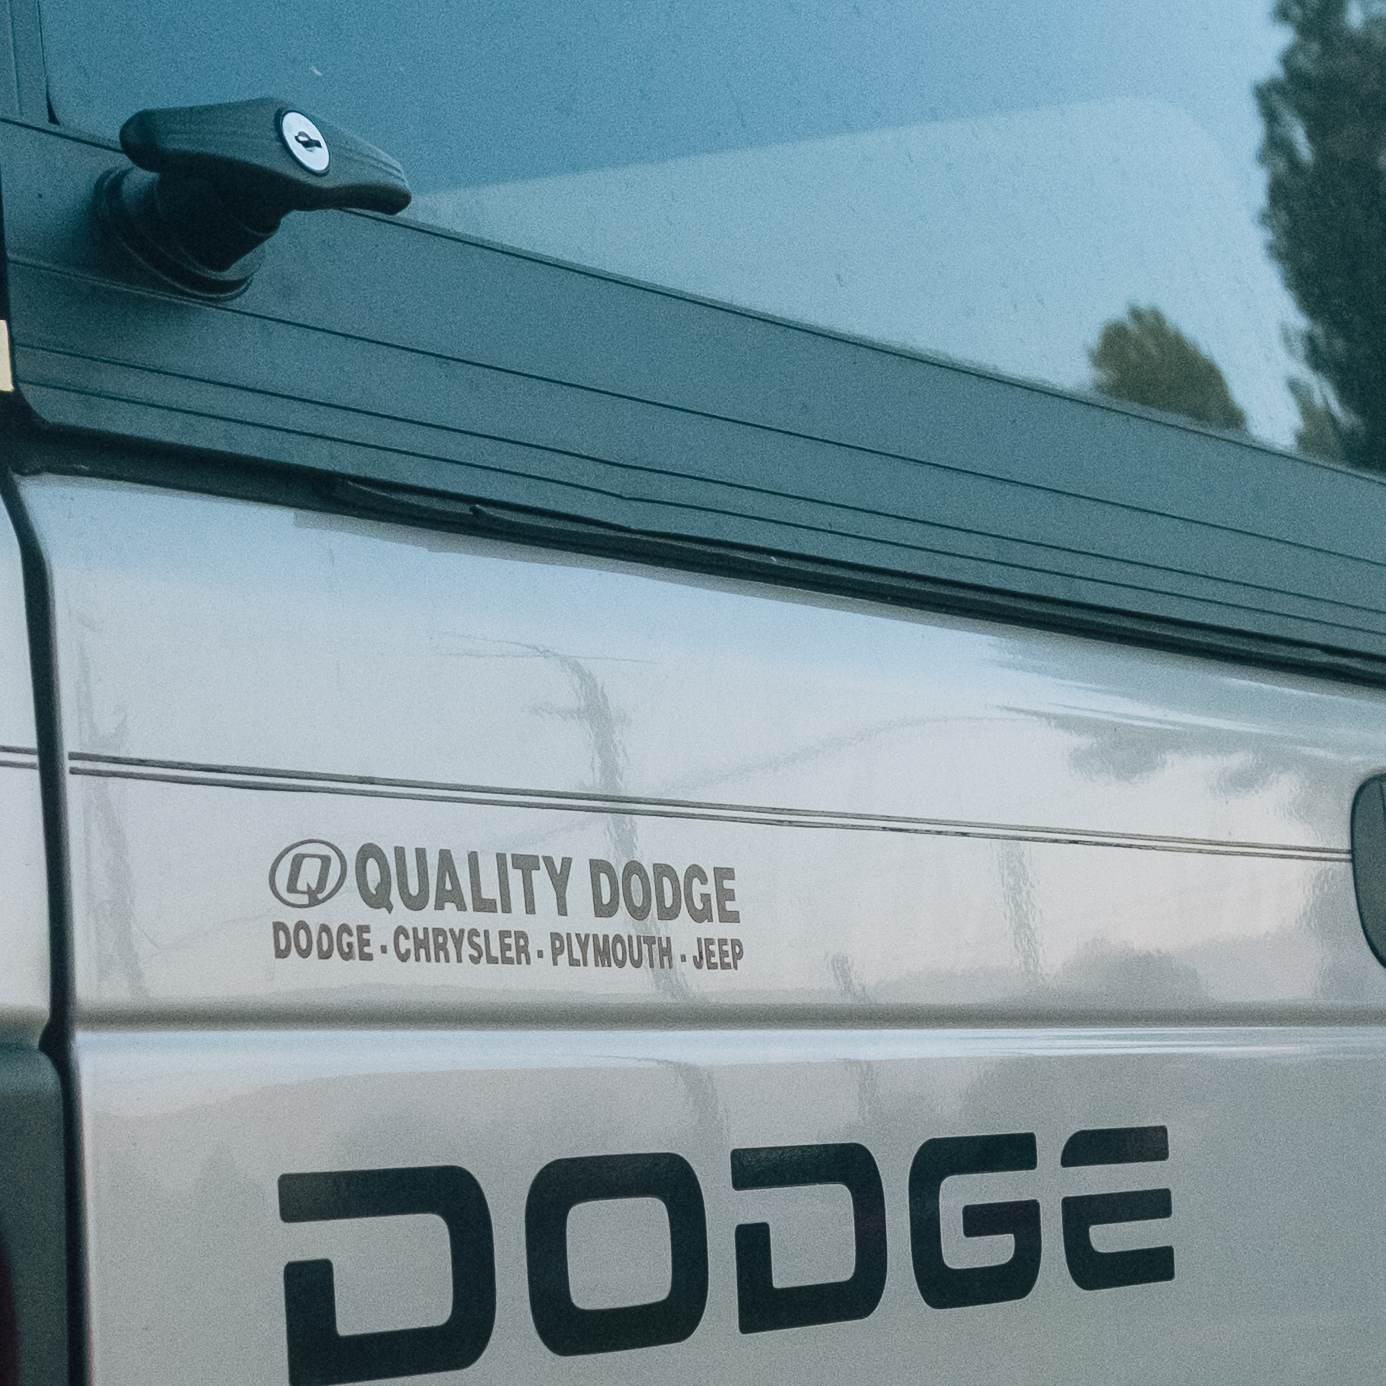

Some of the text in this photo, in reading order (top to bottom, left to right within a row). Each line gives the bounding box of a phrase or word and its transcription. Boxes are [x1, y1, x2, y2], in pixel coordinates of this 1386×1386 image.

[355, 842, 573, 916] QUALITY
[589, 858, 741, 924] DODGE
[272, 920, 745, 971] DODGE CHRYSLER PLYMOUTH JEEP
